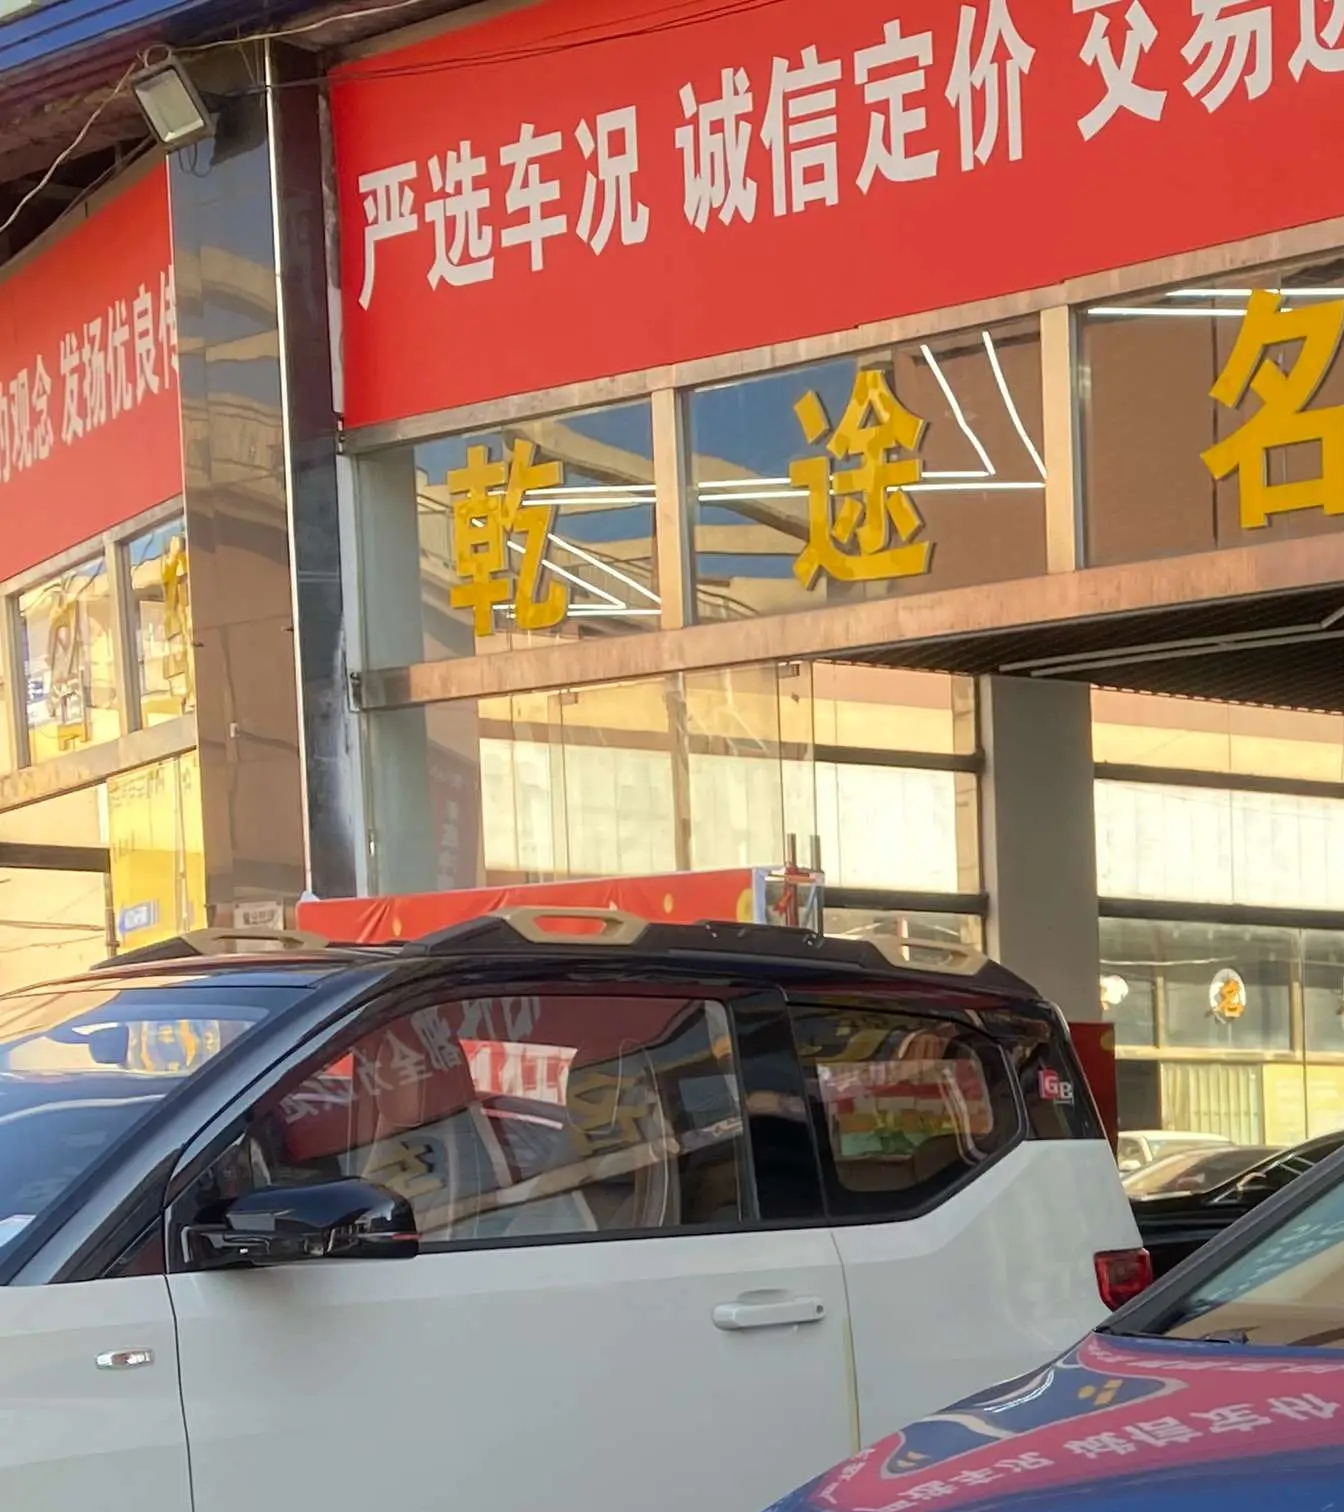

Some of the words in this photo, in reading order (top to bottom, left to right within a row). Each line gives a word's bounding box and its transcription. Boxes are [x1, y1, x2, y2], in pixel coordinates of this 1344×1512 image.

[358, 105, 649, 310] 严选车况
[675, 4, 1035, 233] 诚信定价
